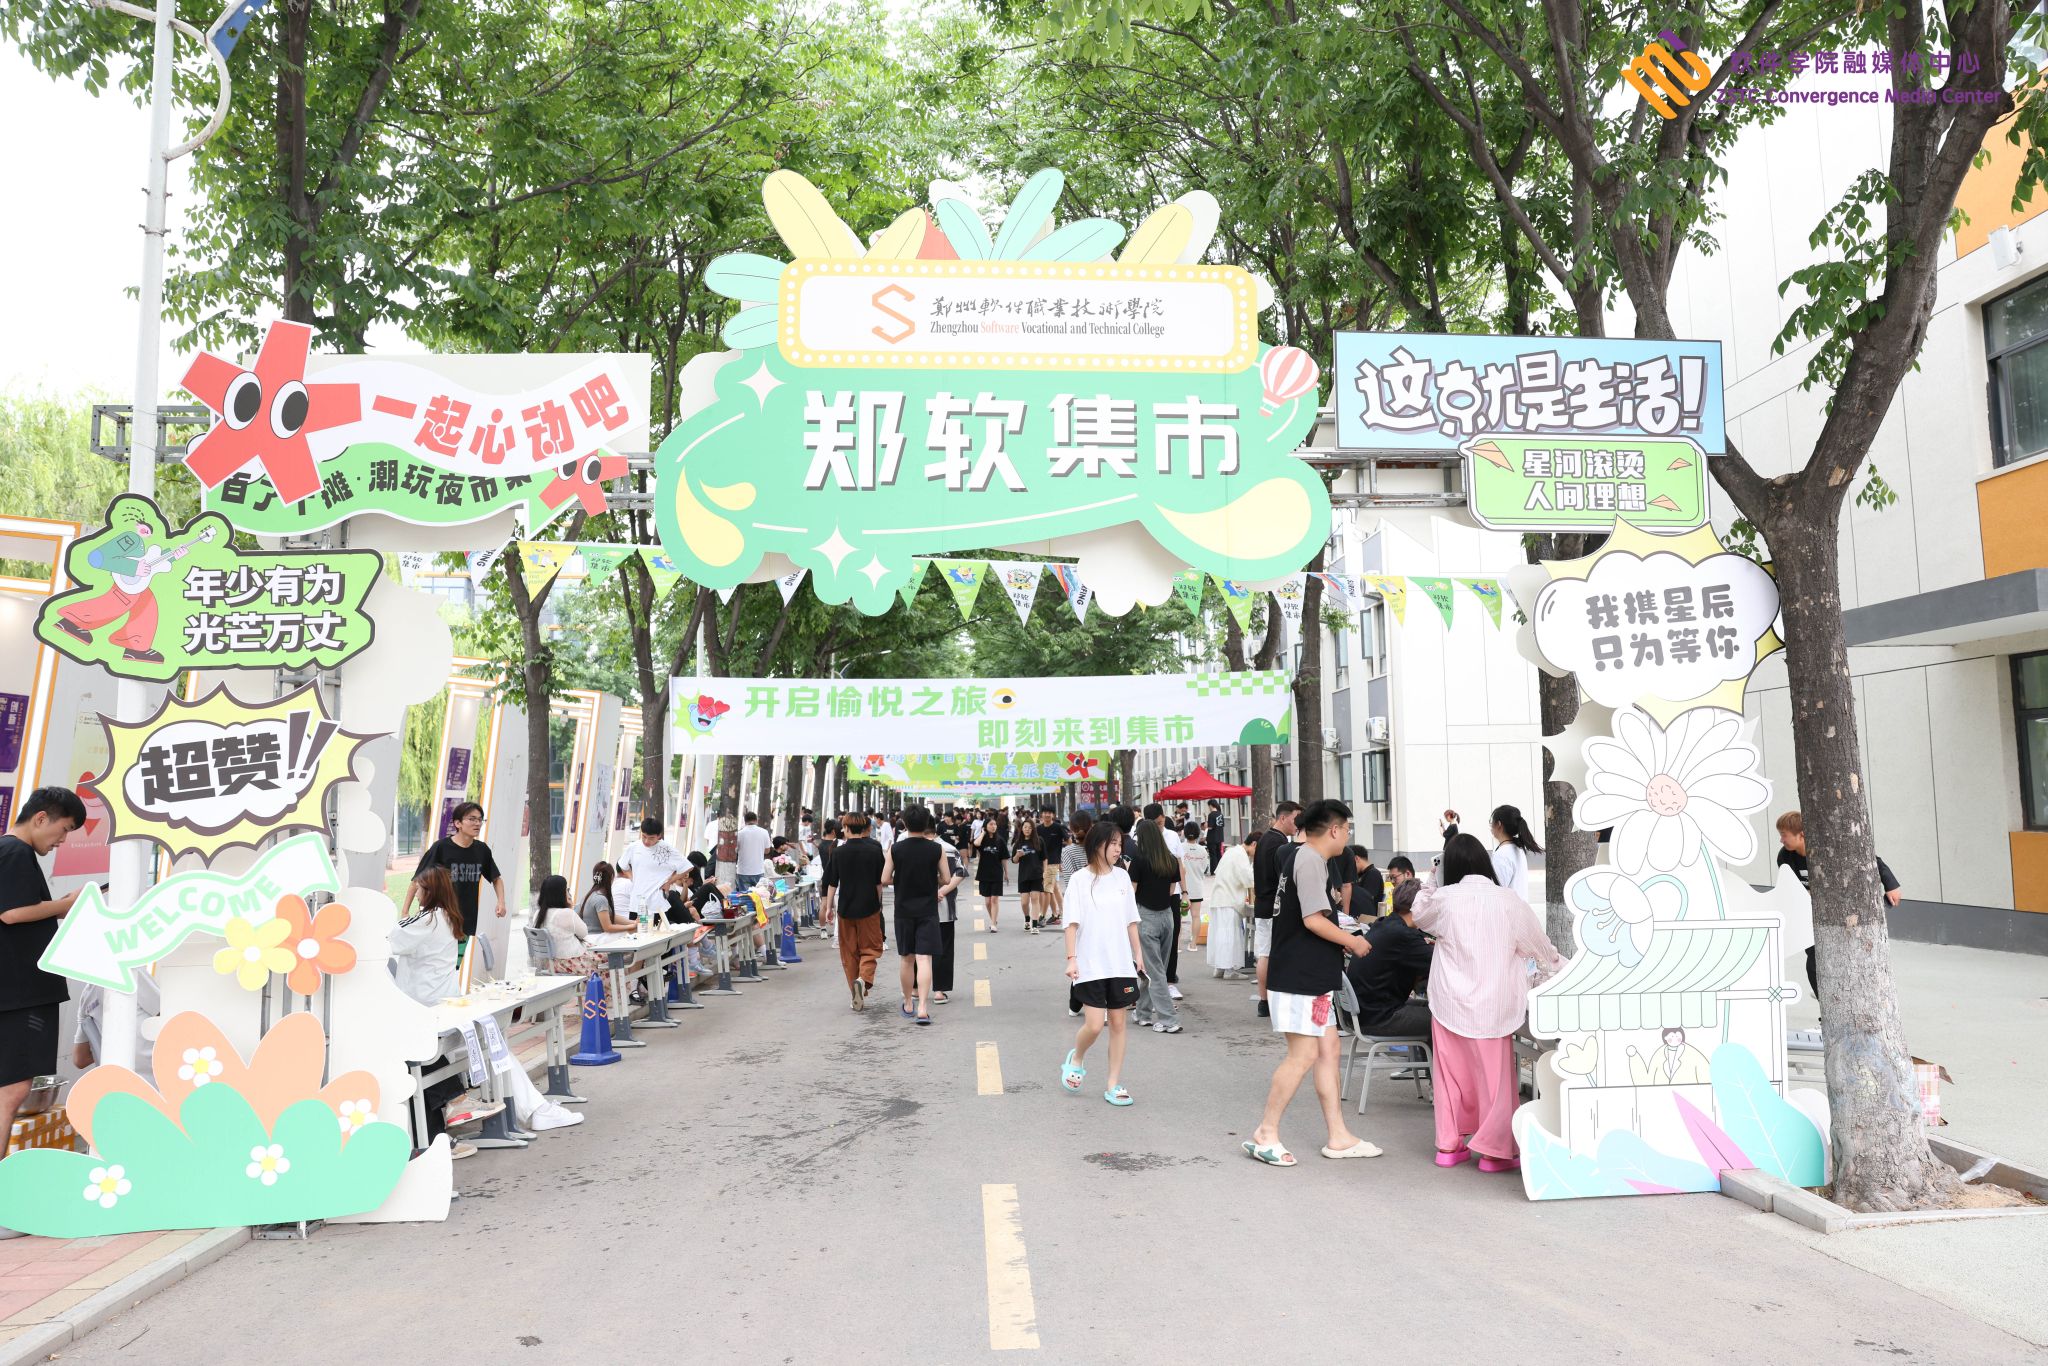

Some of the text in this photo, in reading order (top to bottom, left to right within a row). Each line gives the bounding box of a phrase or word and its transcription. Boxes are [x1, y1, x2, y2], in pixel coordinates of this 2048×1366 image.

[930, 321, 1165, 338] Zhengzhou Software Vocational and Technical College
[1354, 345, 1707, 436] 这就是生活!
[372, 373, 629, 465] 一起心动吧
[803, 390, 1240, 492] 郑软集市
[1522, 449, 1646, 480] 星河滚烫
[1523, 481, 1648, 512] 人间理想
[183, 564, 343, 607] 年少有为
[1585, 584, 1734, 630] 我携星辰
[183, 612, 343, 653] 光芒万丈
[1592, 625, 1740, 672] 只为等你
[744, 685, 987, 718] 开启愉悦之旅
[978, 715, 1196, 748] 即刻来到集市
[981, 763, 1061, 779] 正在派送
[104, 875, 282, 954] WELCOME
